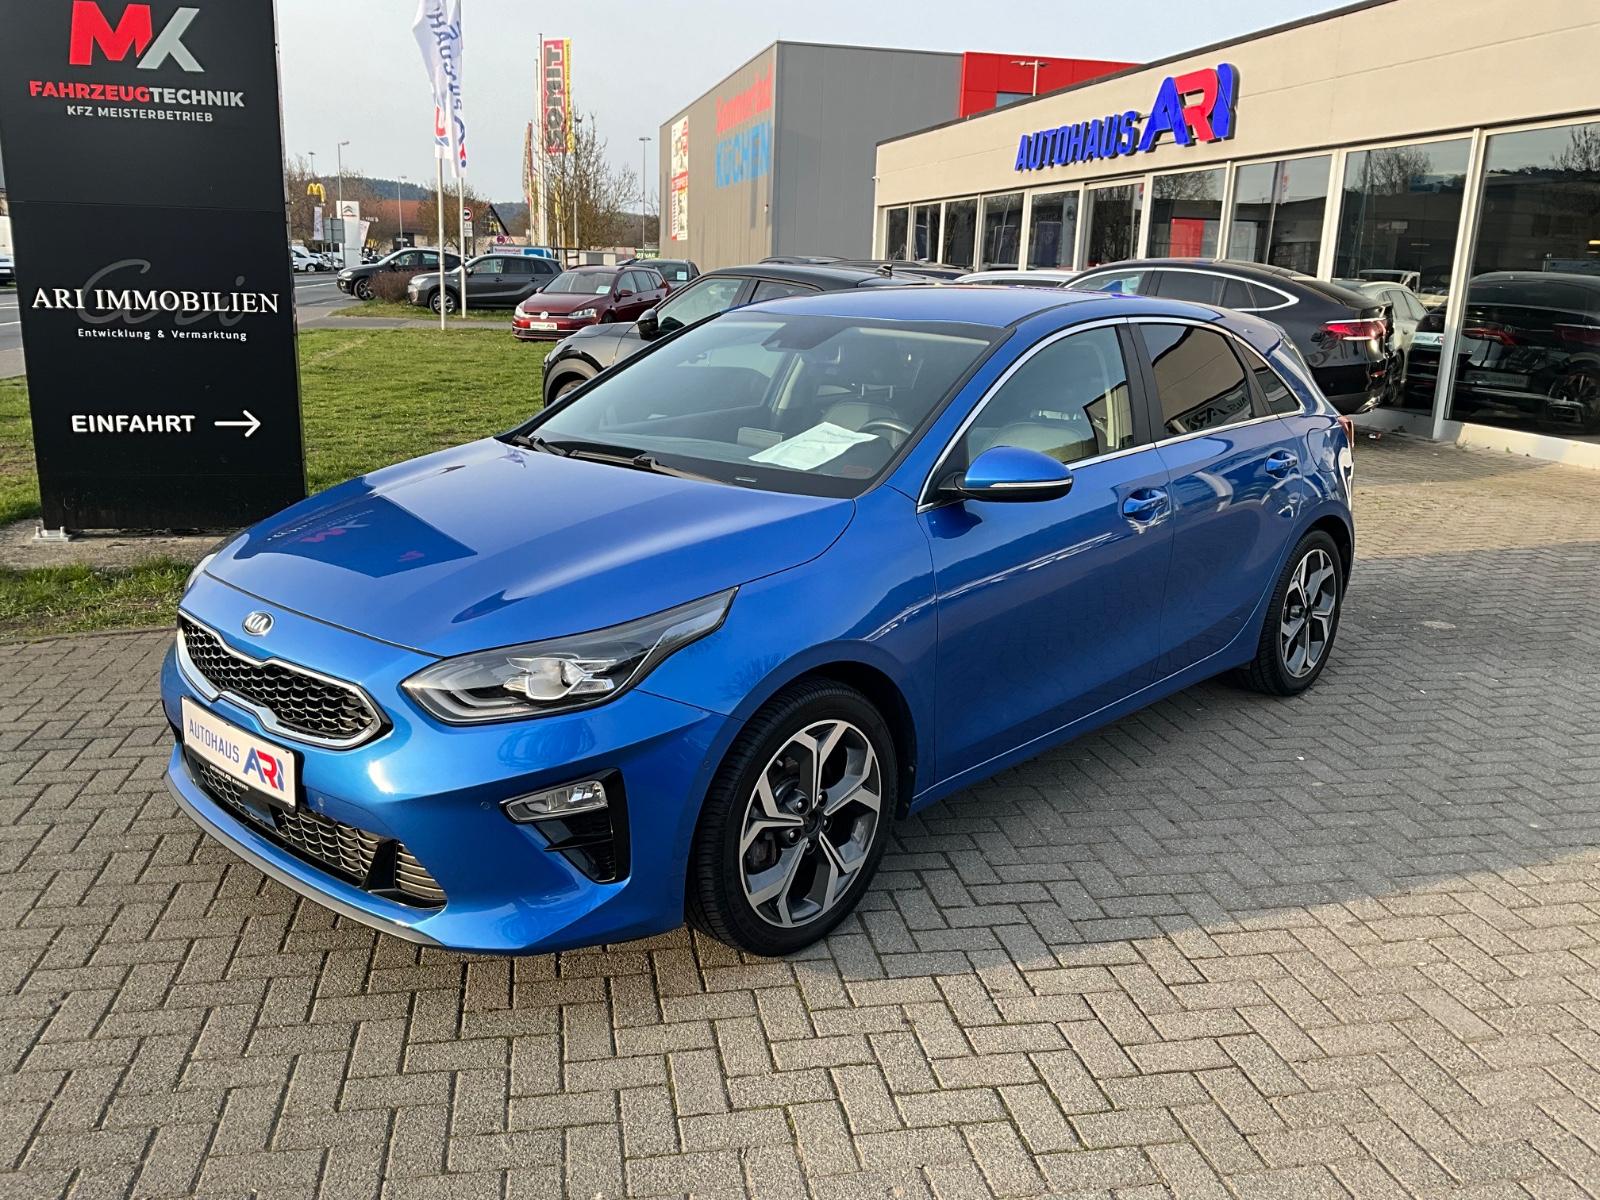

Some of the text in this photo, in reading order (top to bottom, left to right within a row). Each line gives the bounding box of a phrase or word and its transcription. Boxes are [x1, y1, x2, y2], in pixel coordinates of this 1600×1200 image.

[69, 0, 205, 72] MK
[29, 80, 245, 107] FAHRZEUGTECHNIK
[67, 105, 213, 122] KFZ MEISTERBETRIEB
[1014, 63, 1238, 172] AUTOHAUS ARI
[32, 287, 279, 313] ARI IMMOBILIEN
[78, 328, 247, 341] Entwicklung & Vermarktung
[71, 414, 196, 432] EINFAHRT
[246, 612, 269, 632] KIA
[189, 718, 240, 763] AUTOHAUS
[243, 746, 285, 792] ARI
